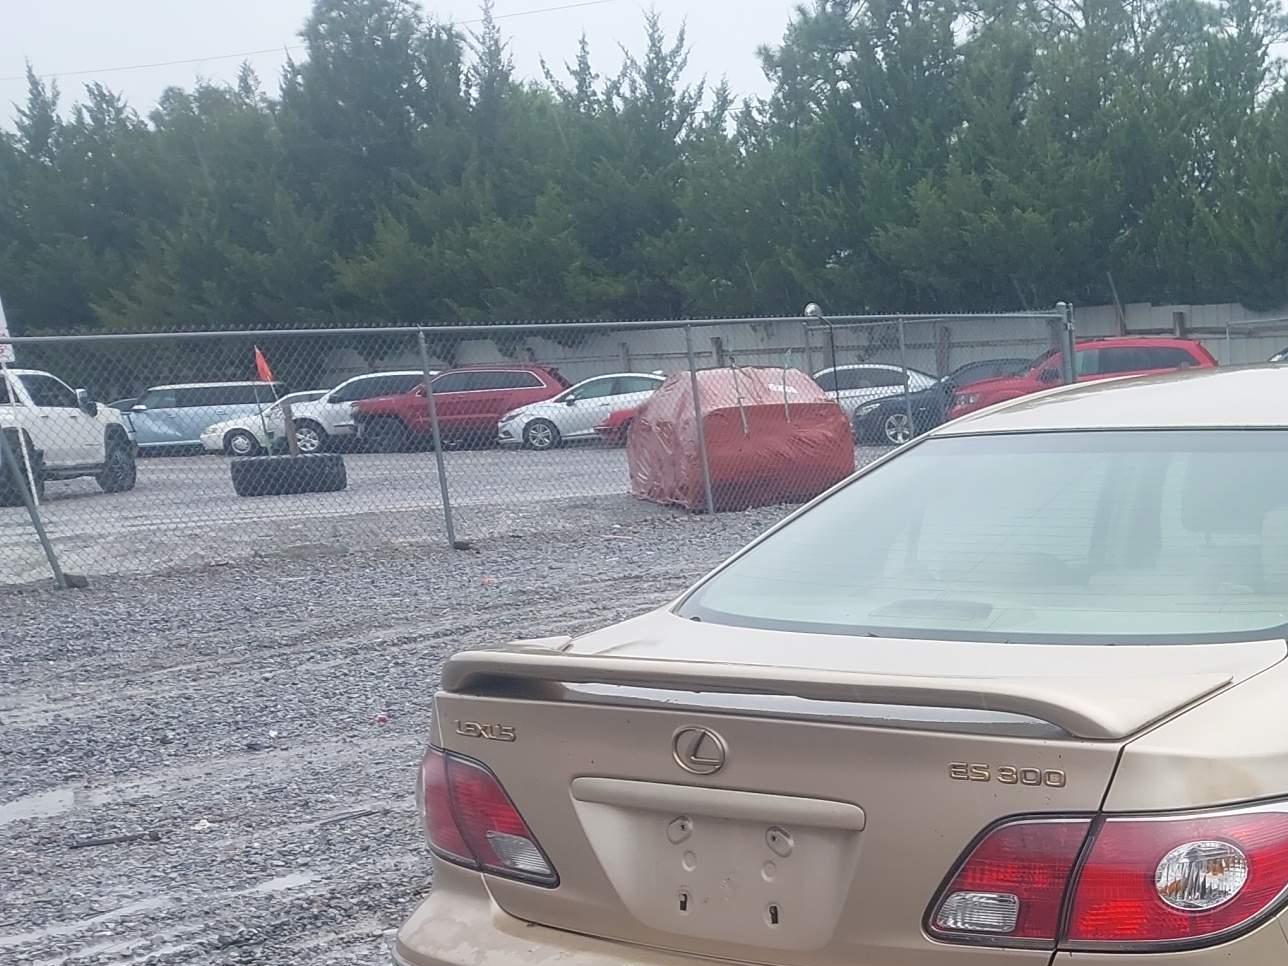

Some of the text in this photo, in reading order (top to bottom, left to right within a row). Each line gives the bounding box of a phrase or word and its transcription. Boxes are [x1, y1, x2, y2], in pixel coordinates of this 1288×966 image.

[453, 719, 516, 742] LEXUS
[949, 761, 1066, 788] ES 300
